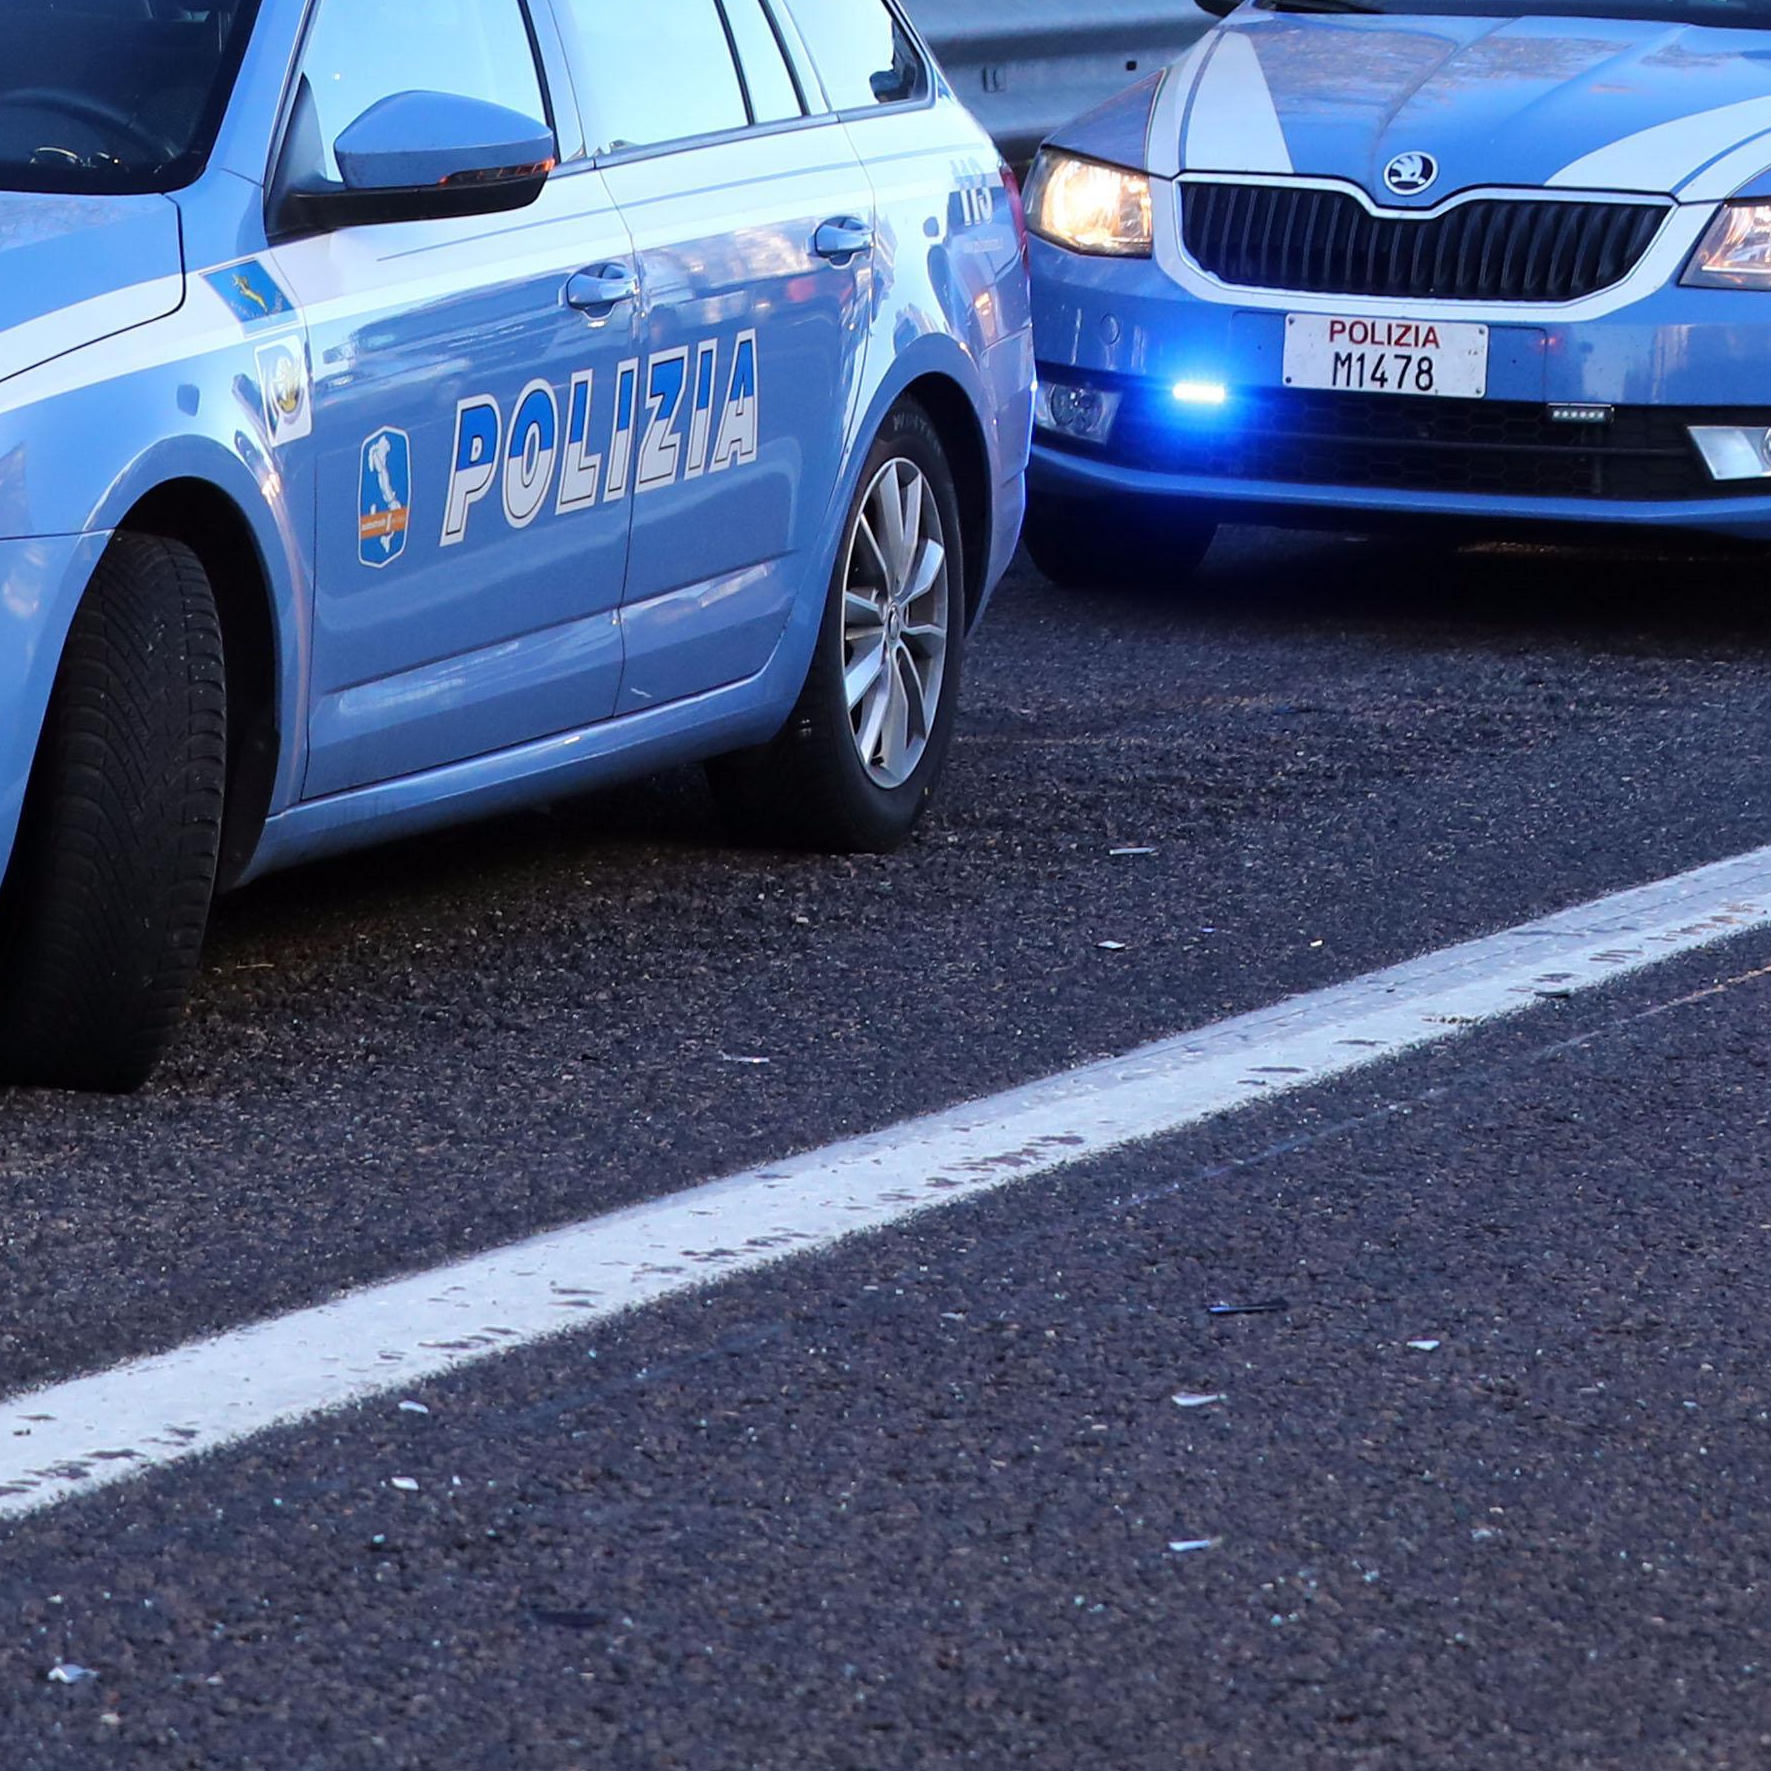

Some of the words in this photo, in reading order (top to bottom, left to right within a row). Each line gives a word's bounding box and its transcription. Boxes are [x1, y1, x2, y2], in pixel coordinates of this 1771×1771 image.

[1329, 319, 1440, 349] POLIZIA
[1331, 351, 1435, 391] M1478
[438, 327, 758, 548] POLIZIA
